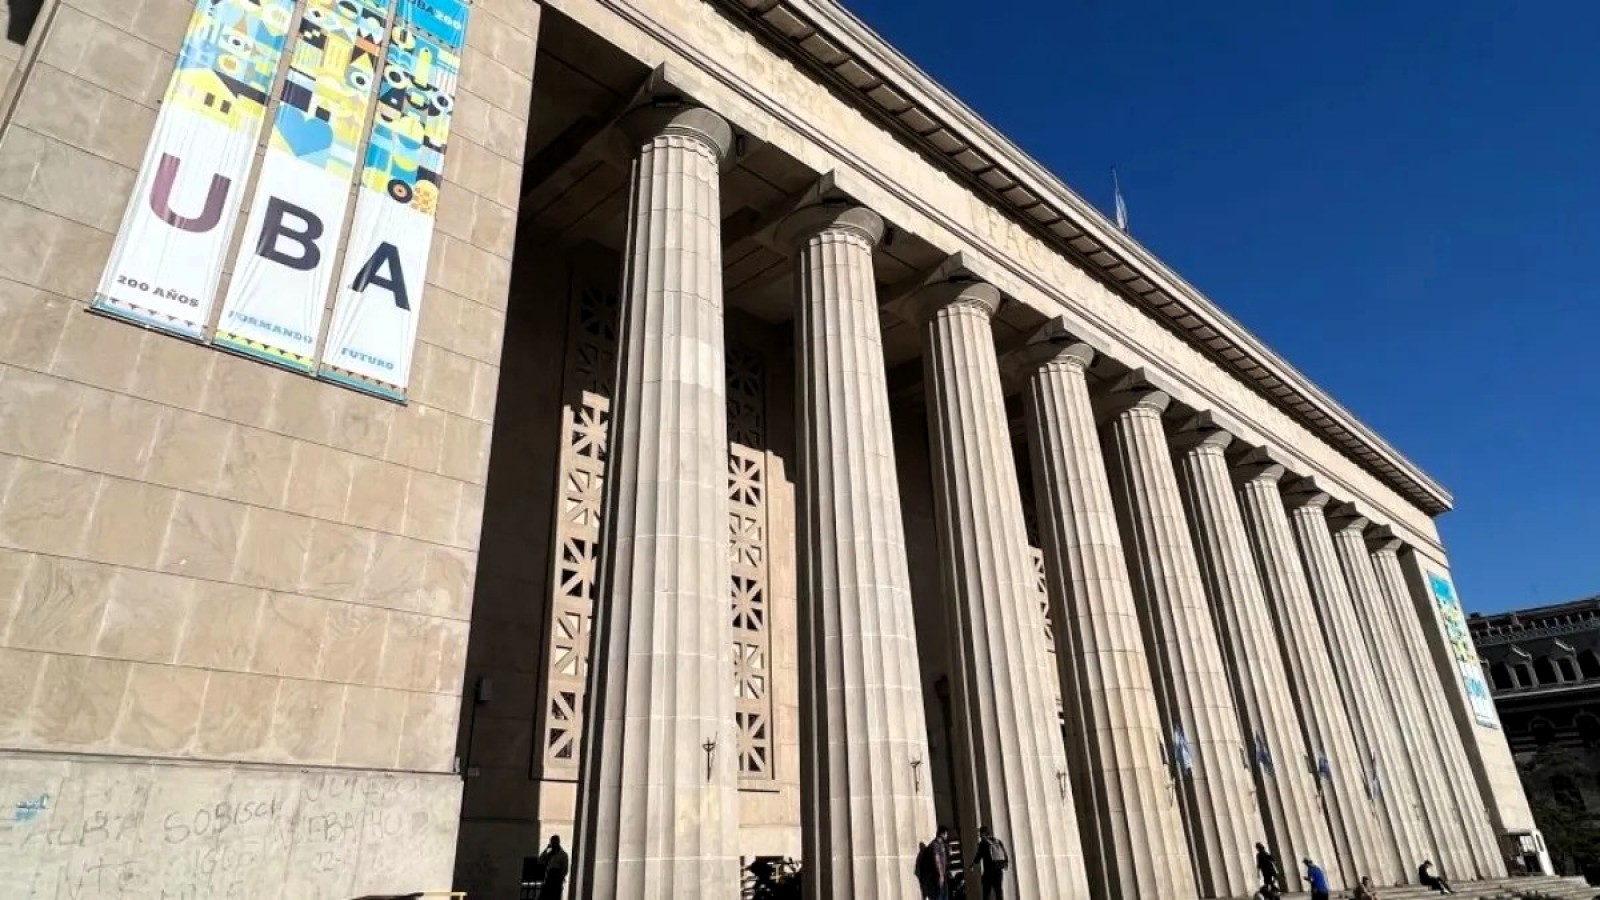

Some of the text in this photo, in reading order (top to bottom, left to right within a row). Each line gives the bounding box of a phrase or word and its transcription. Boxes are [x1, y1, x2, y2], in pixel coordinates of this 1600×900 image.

[116, 274, 200, 308] 200 AÑOS
[340, 346, 395, 371] FUTURO
